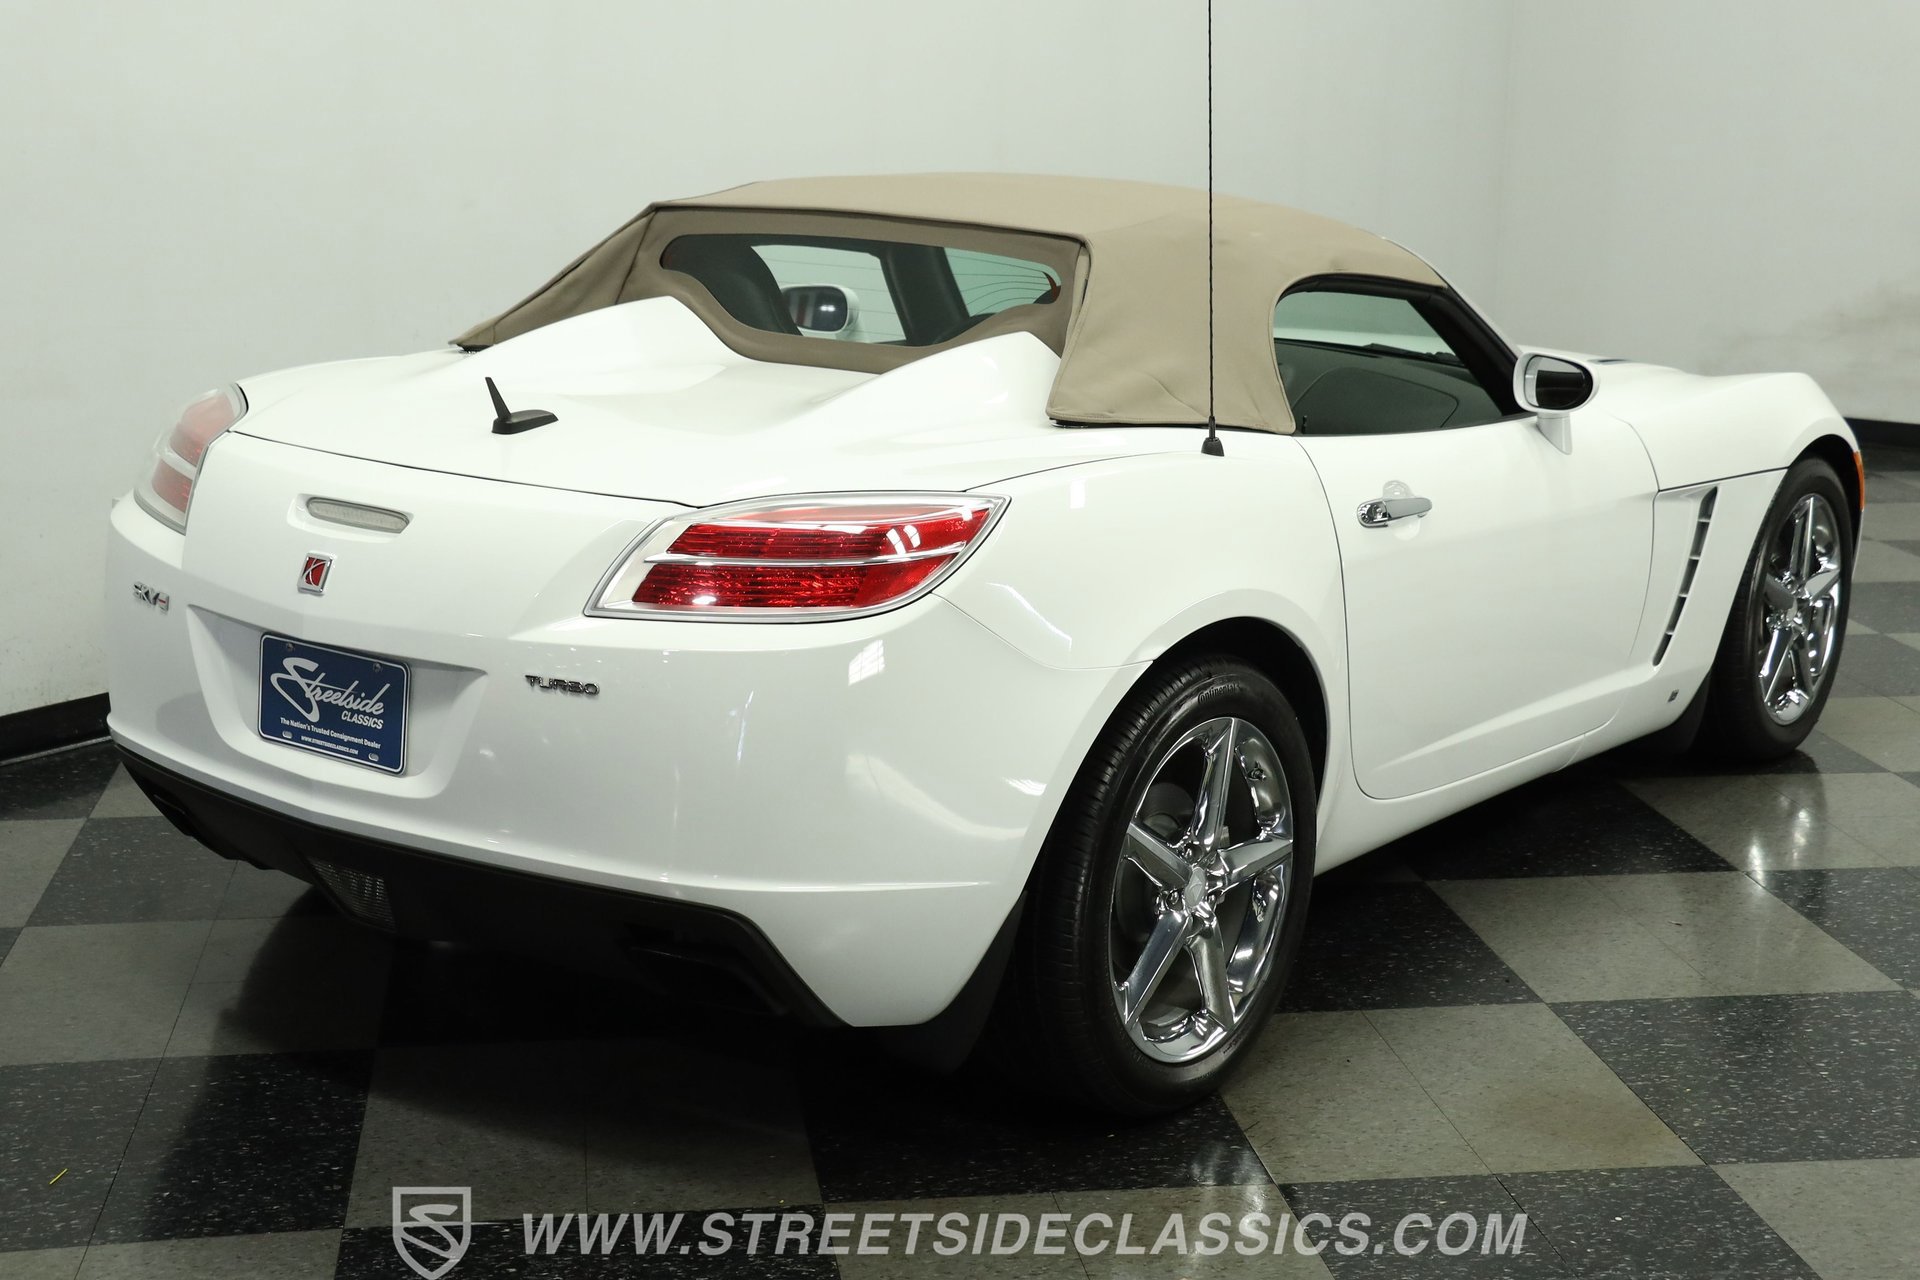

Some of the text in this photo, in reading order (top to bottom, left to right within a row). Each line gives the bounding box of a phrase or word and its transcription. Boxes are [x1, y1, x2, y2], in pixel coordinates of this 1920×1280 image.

[270, 657, 390, 723] Streetside
[525, 675, 600, 696] TURBO
[280, 717, 382, 749] The Nation's Trusted Consignment Dealer
[341, 710, 384, 730] CLASSICS
